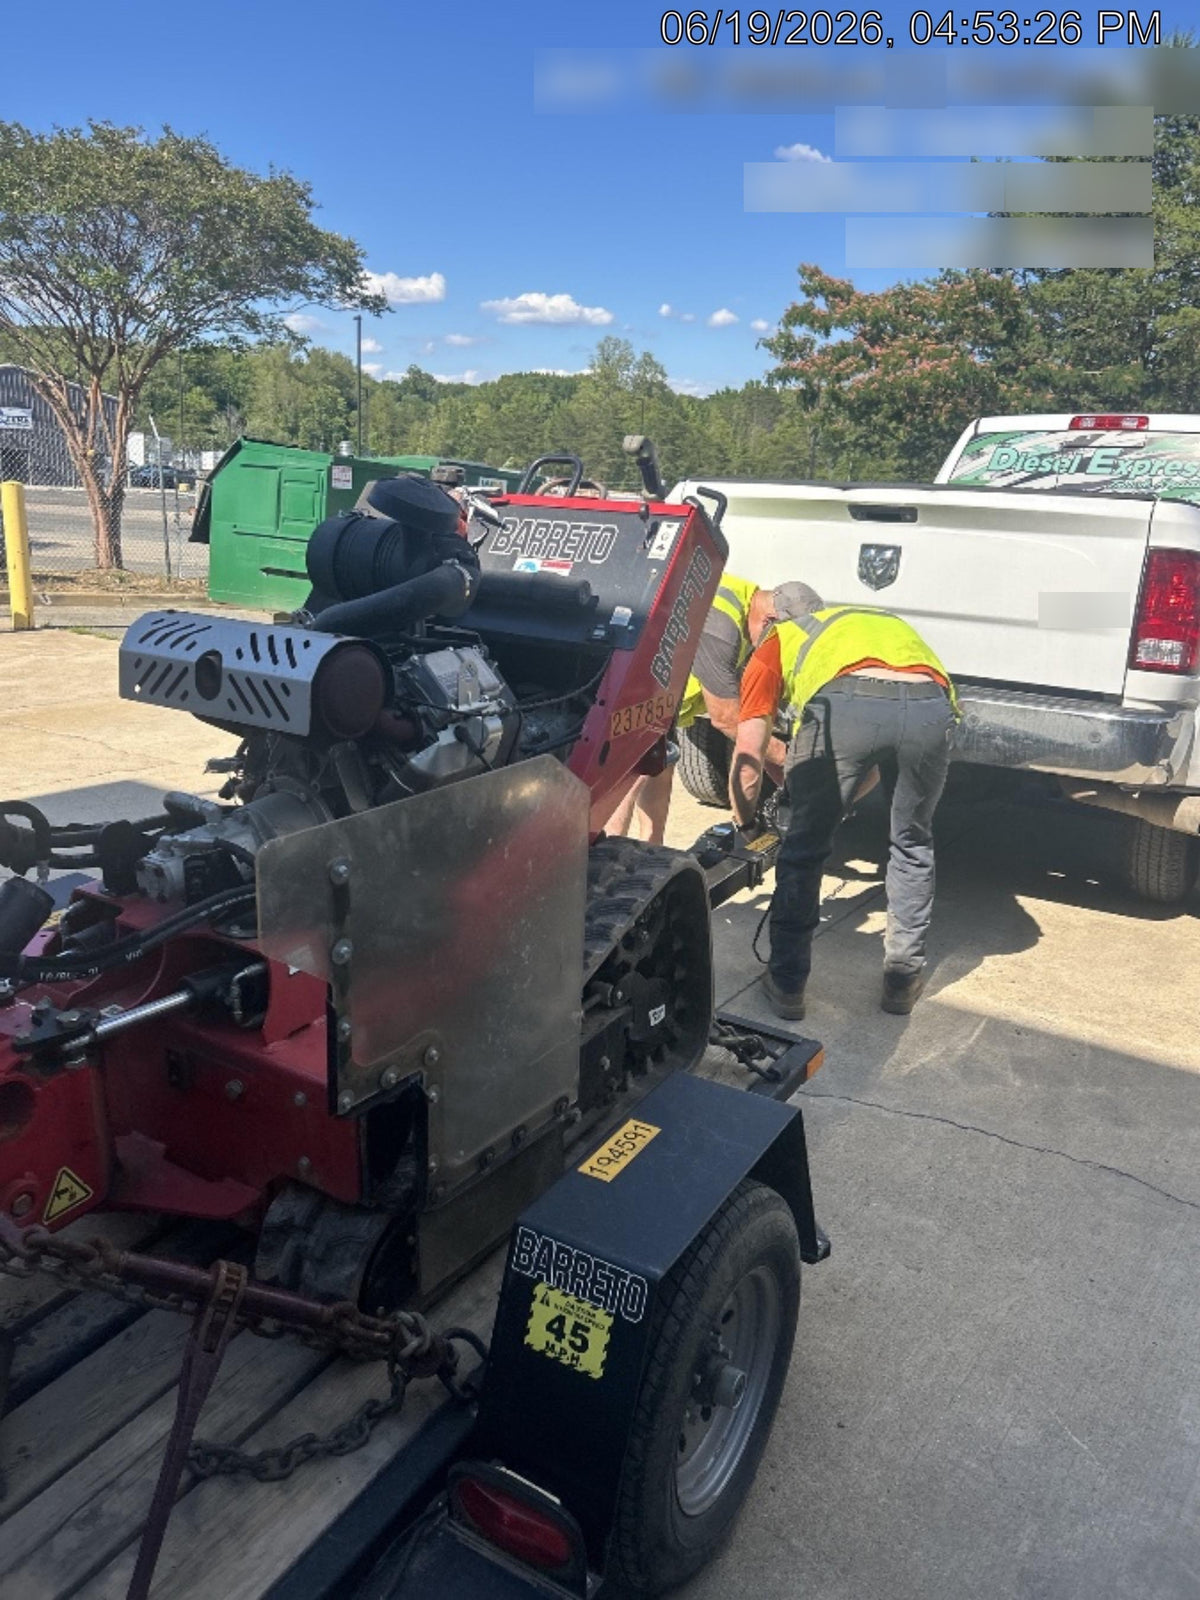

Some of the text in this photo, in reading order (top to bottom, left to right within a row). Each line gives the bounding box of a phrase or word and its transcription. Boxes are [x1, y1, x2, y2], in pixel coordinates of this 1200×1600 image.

[987, 447, 1200, 479] Diesel Expres
[489, 517, 618, 564] BARRETO
[651, 545, 712, 690] BARRETO
[589, 1125, 652, 1176] 194591
[511, 1226, 648, 1323] BARRETO
[546, 1313, 590, 1354] 45
